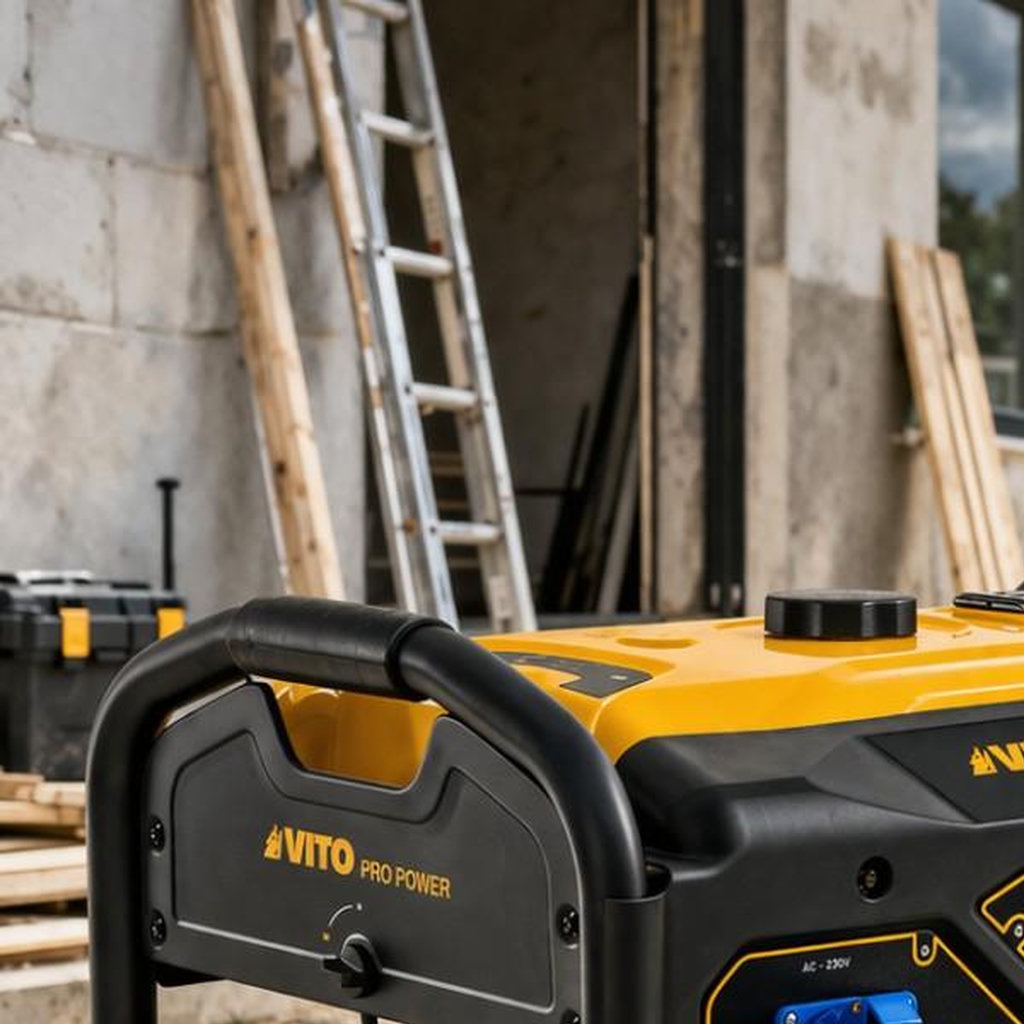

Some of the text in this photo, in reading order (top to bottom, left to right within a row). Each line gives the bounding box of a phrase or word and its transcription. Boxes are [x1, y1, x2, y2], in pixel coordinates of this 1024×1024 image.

[283, 826, 450, 898] VITO PRO POWER
